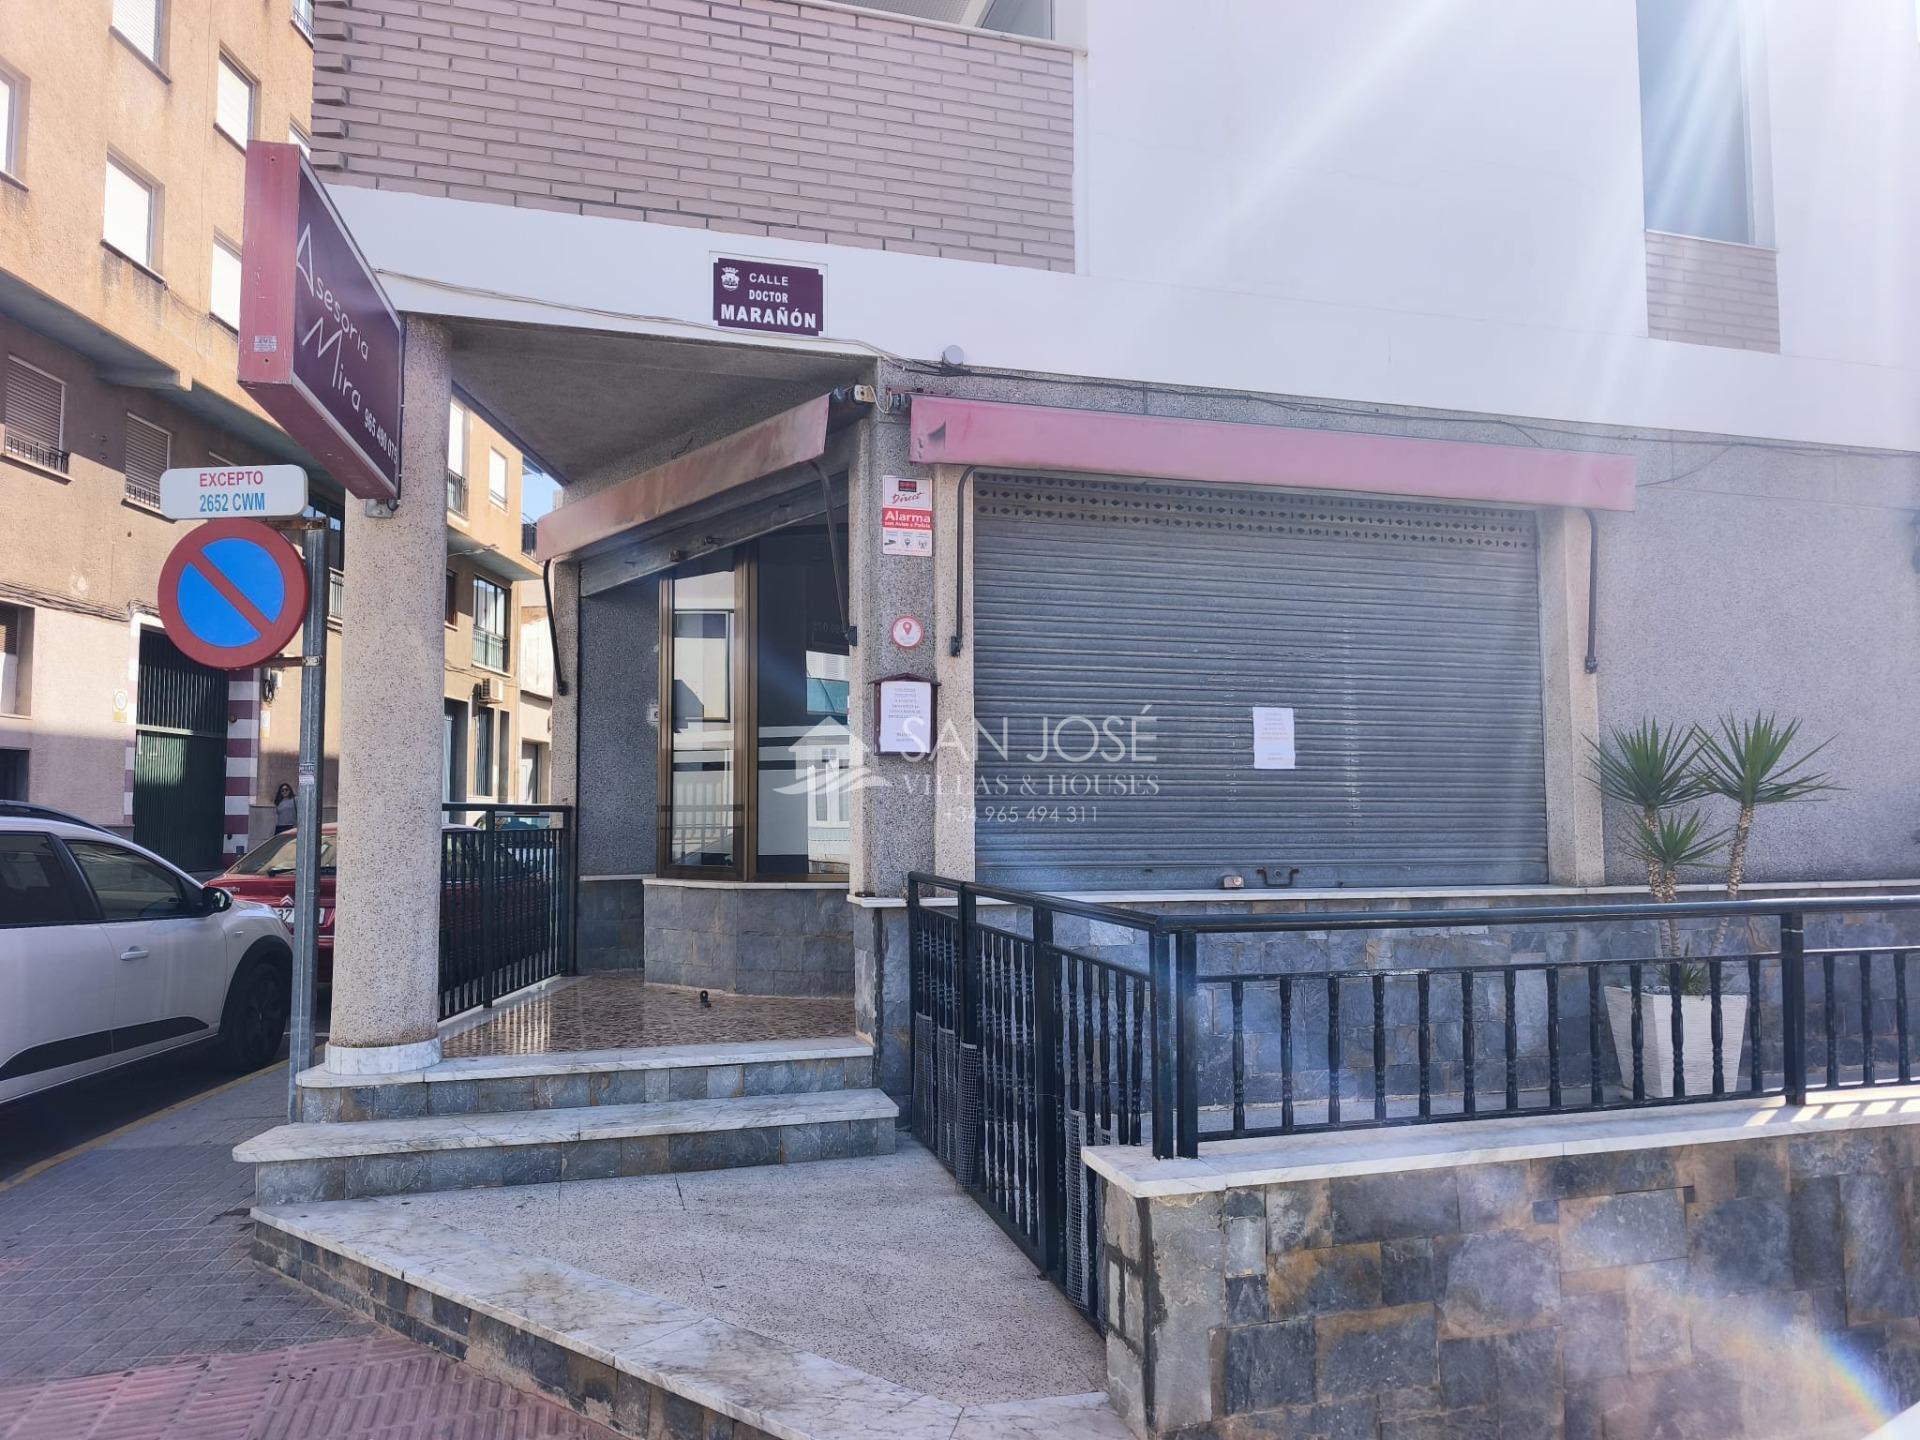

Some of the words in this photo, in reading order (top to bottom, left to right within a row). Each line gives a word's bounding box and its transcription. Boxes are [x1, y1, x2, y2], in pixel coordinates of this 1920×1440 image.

[749, 273, 789, 286] CALLE
[296, 223, 369, 361] Asesoria
[748, 289, 789, 303] DOCTOR
[721, 304, 816, 328] MARAÑÓN
[302, 316, 361, 412] Mira
[364, 408, 376, 437] 965
[199, 470, 264, 487] EXCEPTO
[199, 493, 229, 512] 2652
[232, 493, 265, 511] CWM
[885, 511, 931, 523] Alarma
